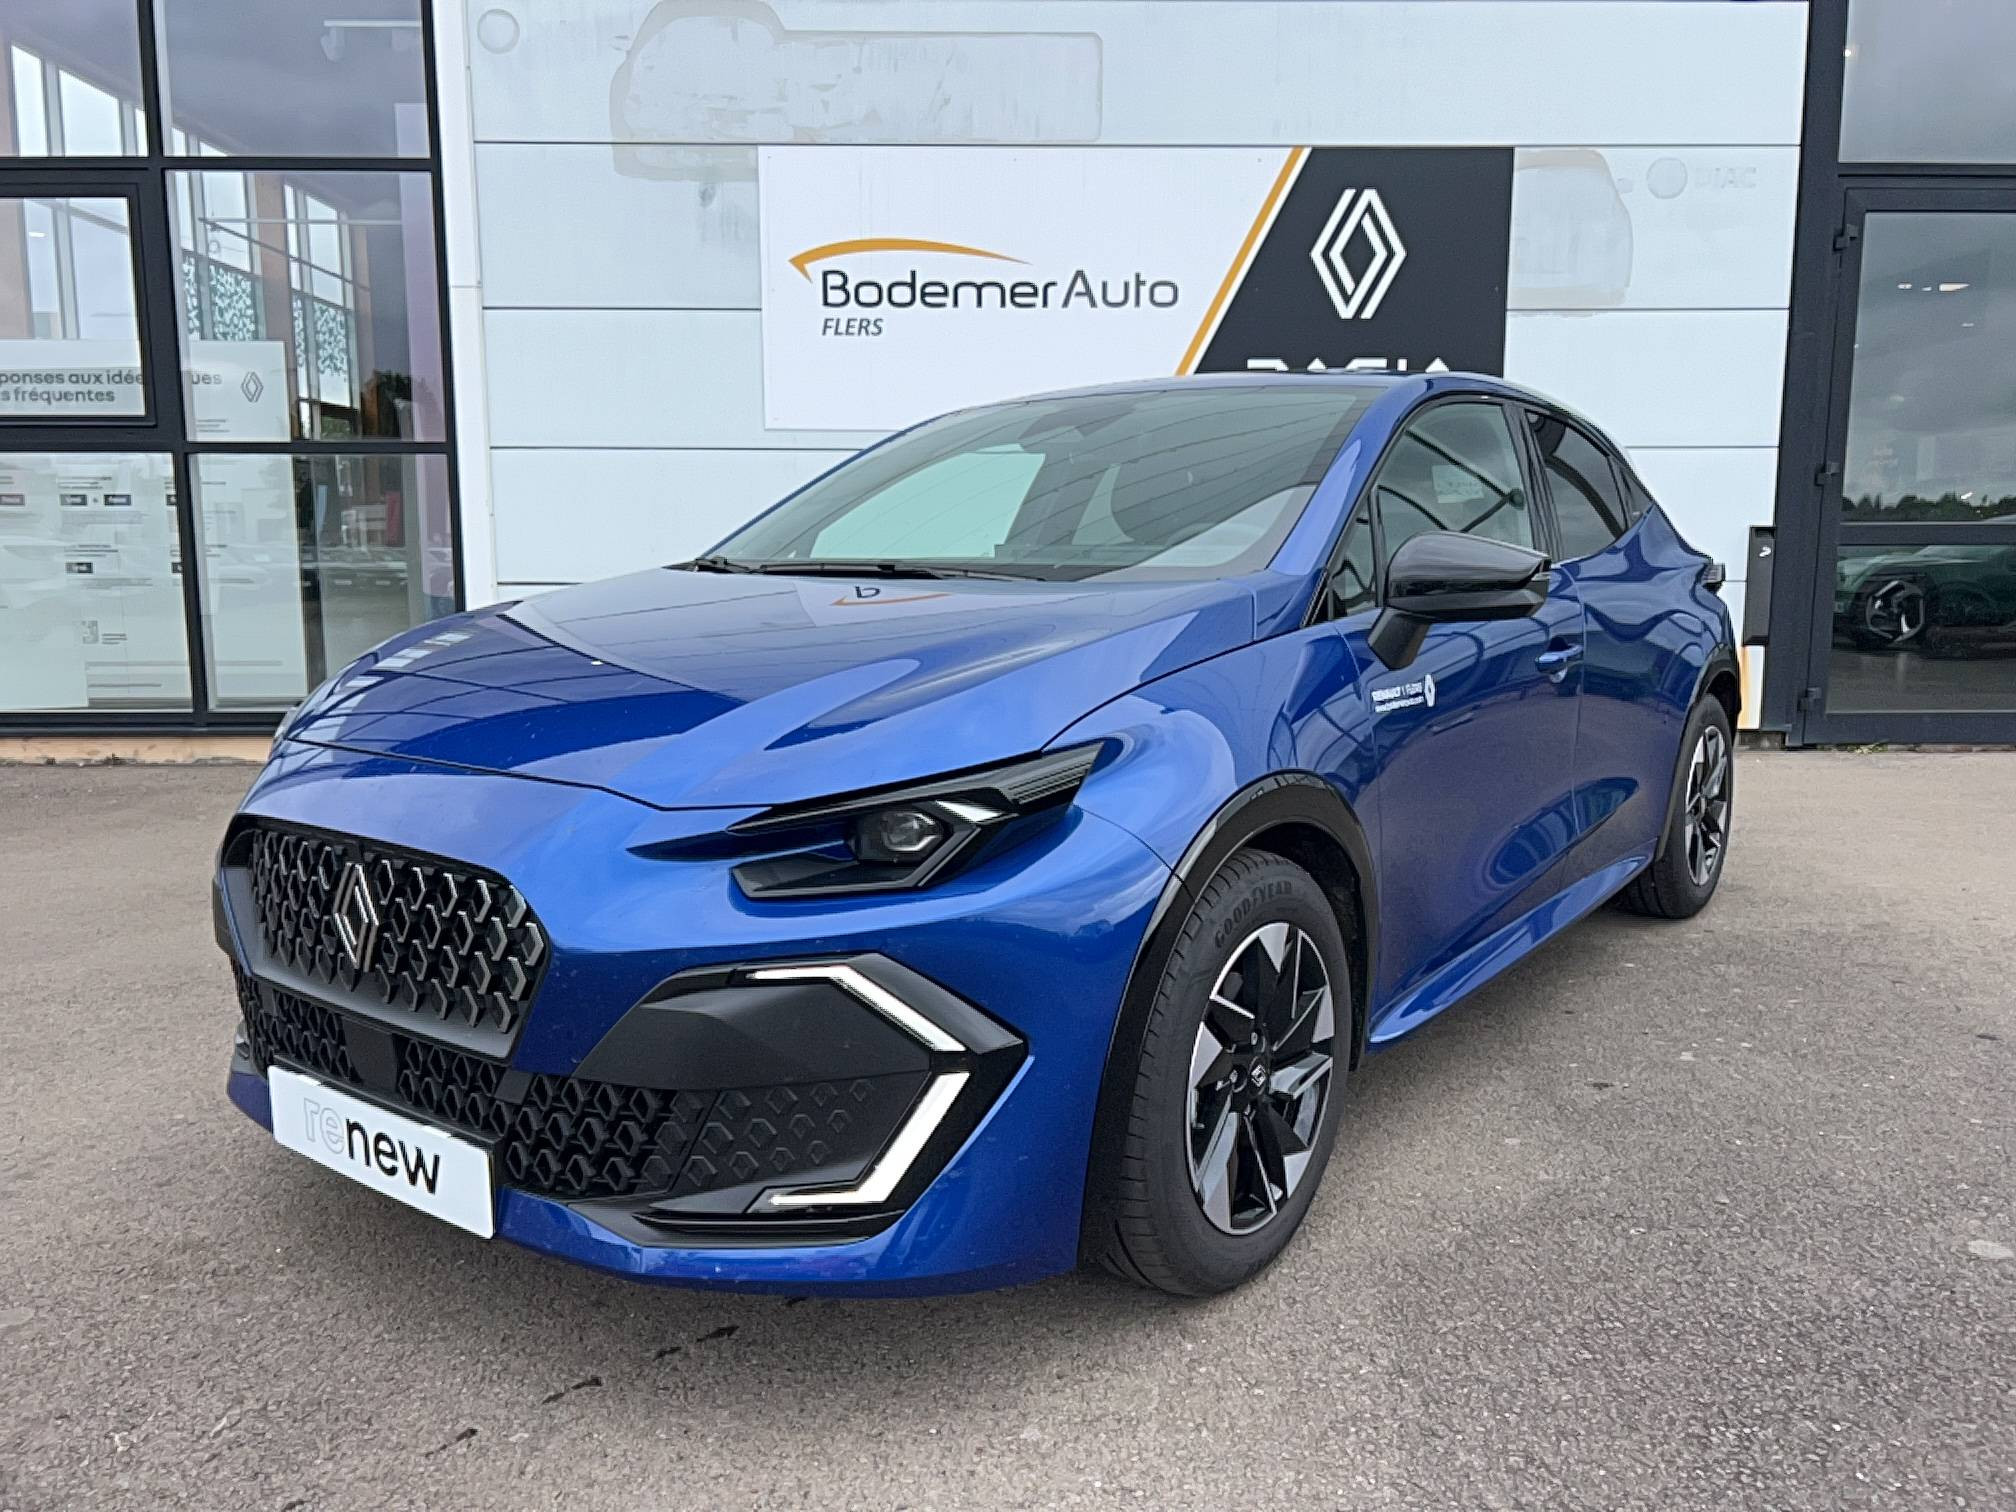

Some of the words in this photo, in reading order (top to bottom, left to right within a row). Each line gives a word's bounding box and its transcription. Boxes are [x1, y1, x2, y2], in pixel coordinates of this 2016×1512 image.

[821, 317, 884, 337] FLERS
[68, 373, 106, 385] aux
[14, 386, 116, 406] fréquentes
[303, 1097, 441, 1196] renew
